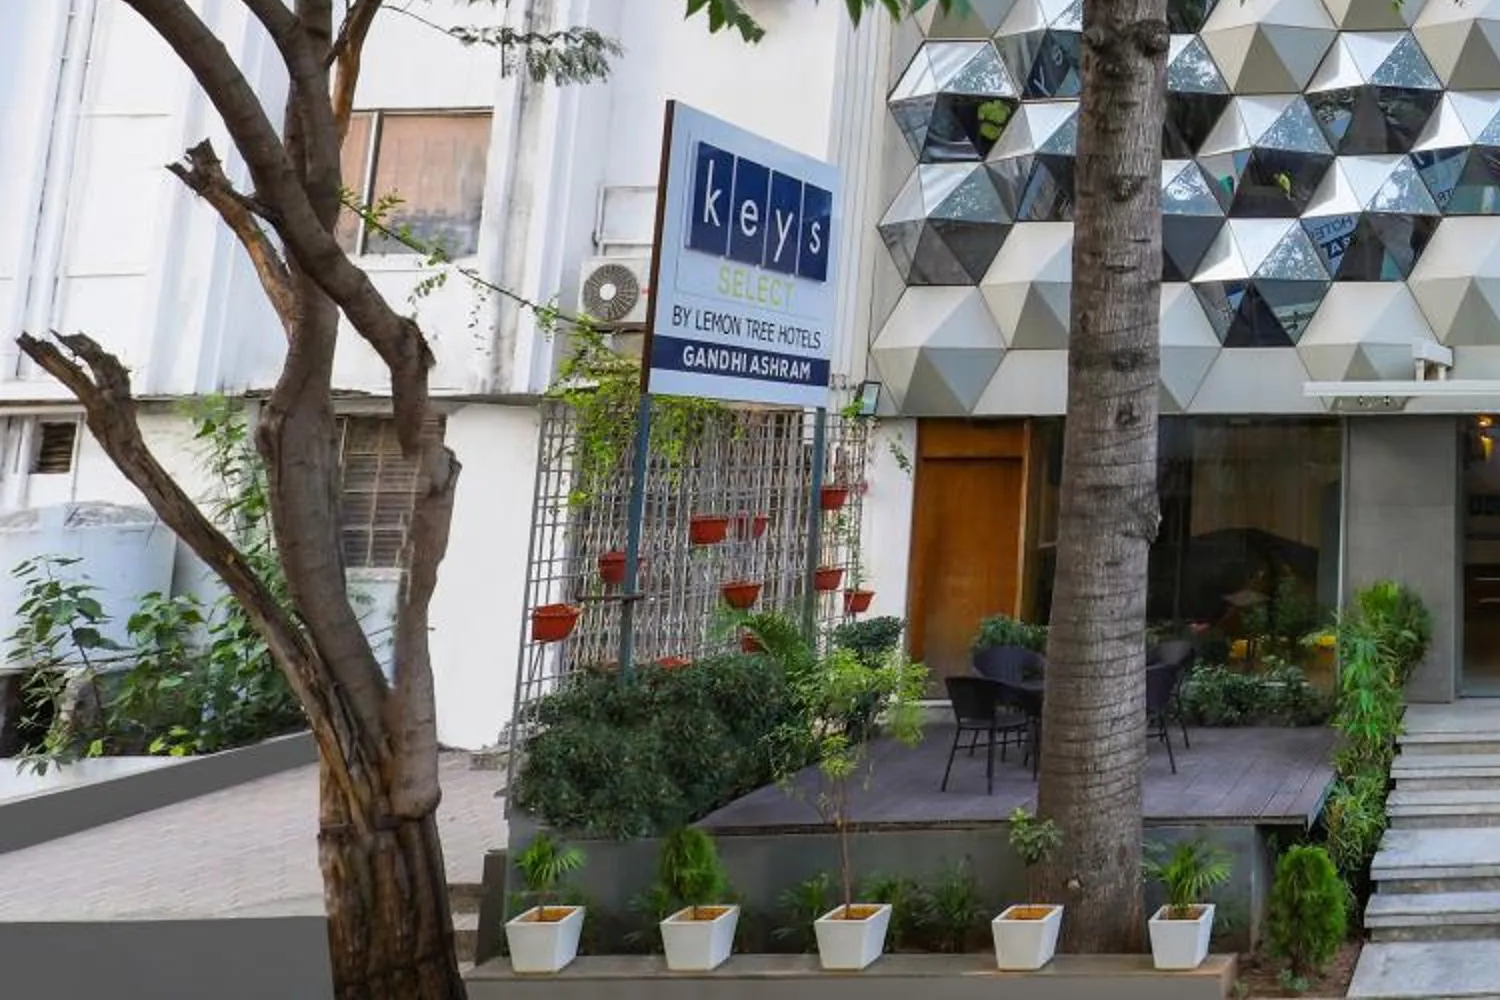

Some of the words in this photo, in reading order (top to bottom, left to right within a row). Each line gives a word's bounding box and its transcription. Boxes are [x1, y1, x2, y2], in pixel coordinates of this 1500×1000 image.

[703, 158, 821, 262] keys
[719, 266, 795, 304] SELECT
[672, 305, 693, 327] BY
[695, 309, 741, 336] LEMON
[745, 318, 775, 343] TREE
[778, 325, 821, 349] HOTELS
[683, 345, 747, 373] GANDHI
[750, 354, 811, 380] ASHRAM
